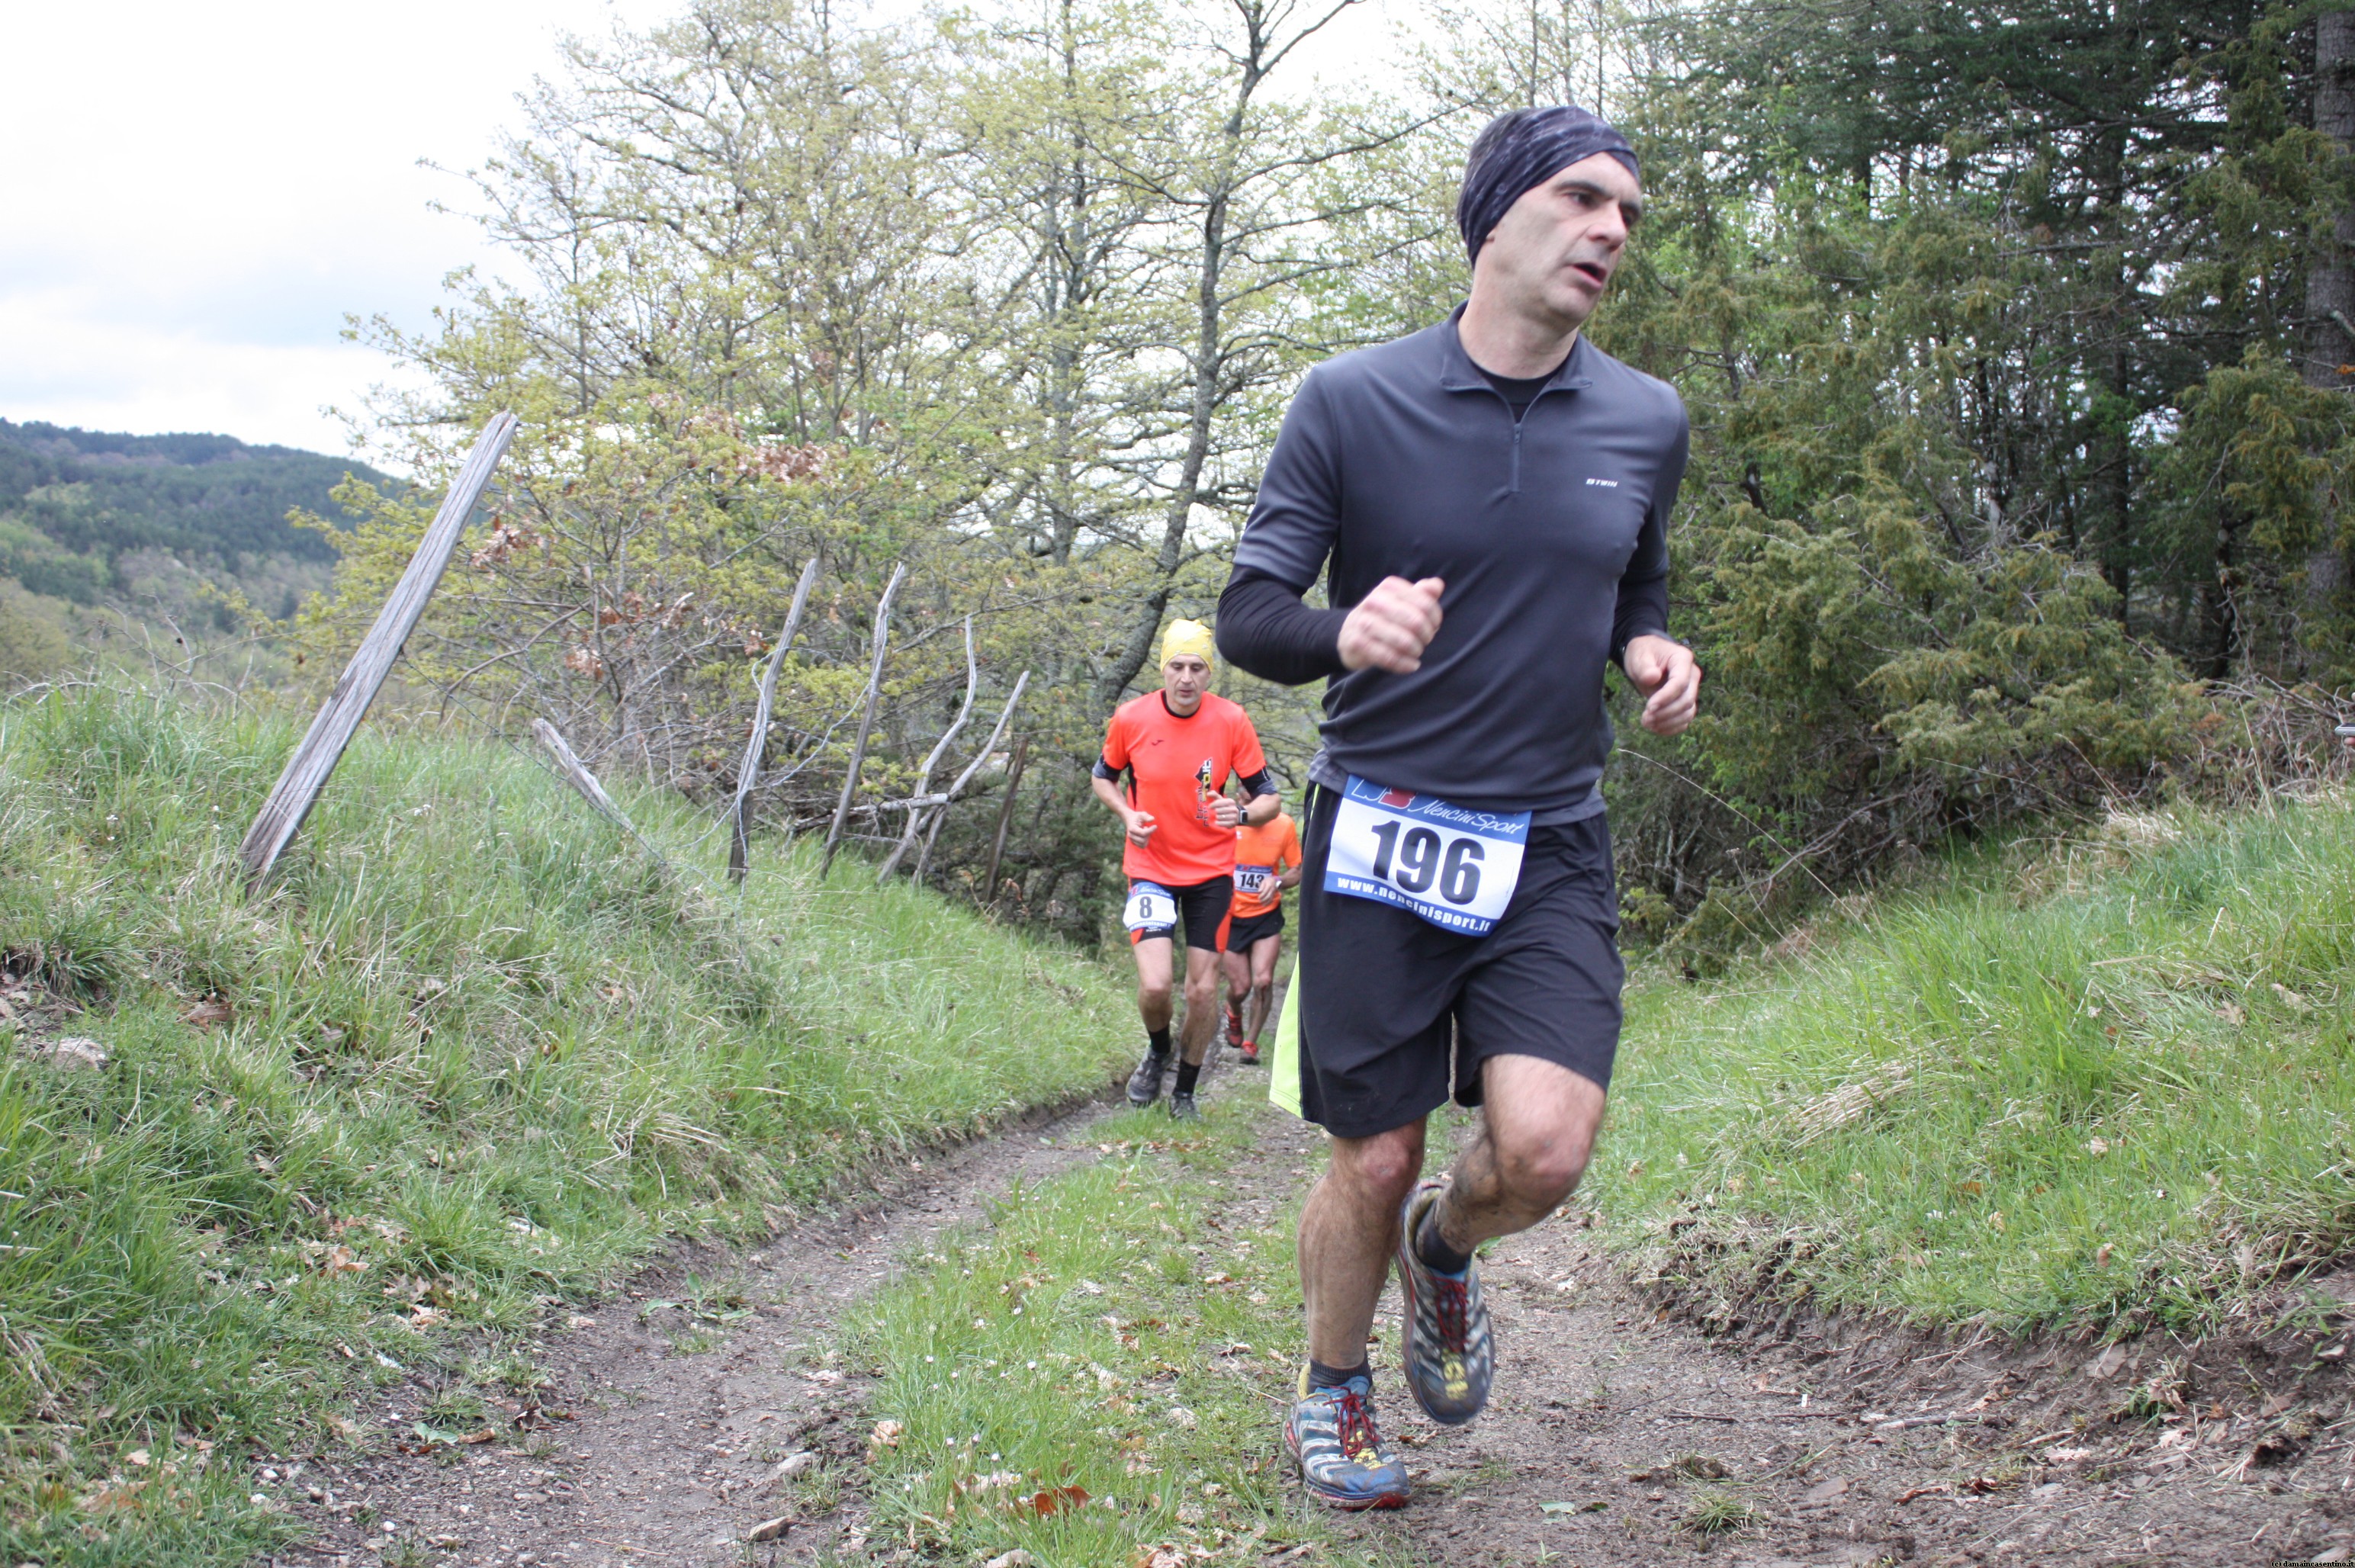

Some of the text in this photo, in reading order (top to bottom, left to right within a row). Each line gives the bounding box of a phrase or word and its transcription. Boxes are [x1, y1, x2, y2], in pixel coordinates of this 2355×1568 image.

[1240, 873, 1264, 888] 143
[1370, 820, 1486, 905] 196
[1139, 896, 1152, 918] 8
[1337, 877, 1490, 932] www.nencinisport.it
